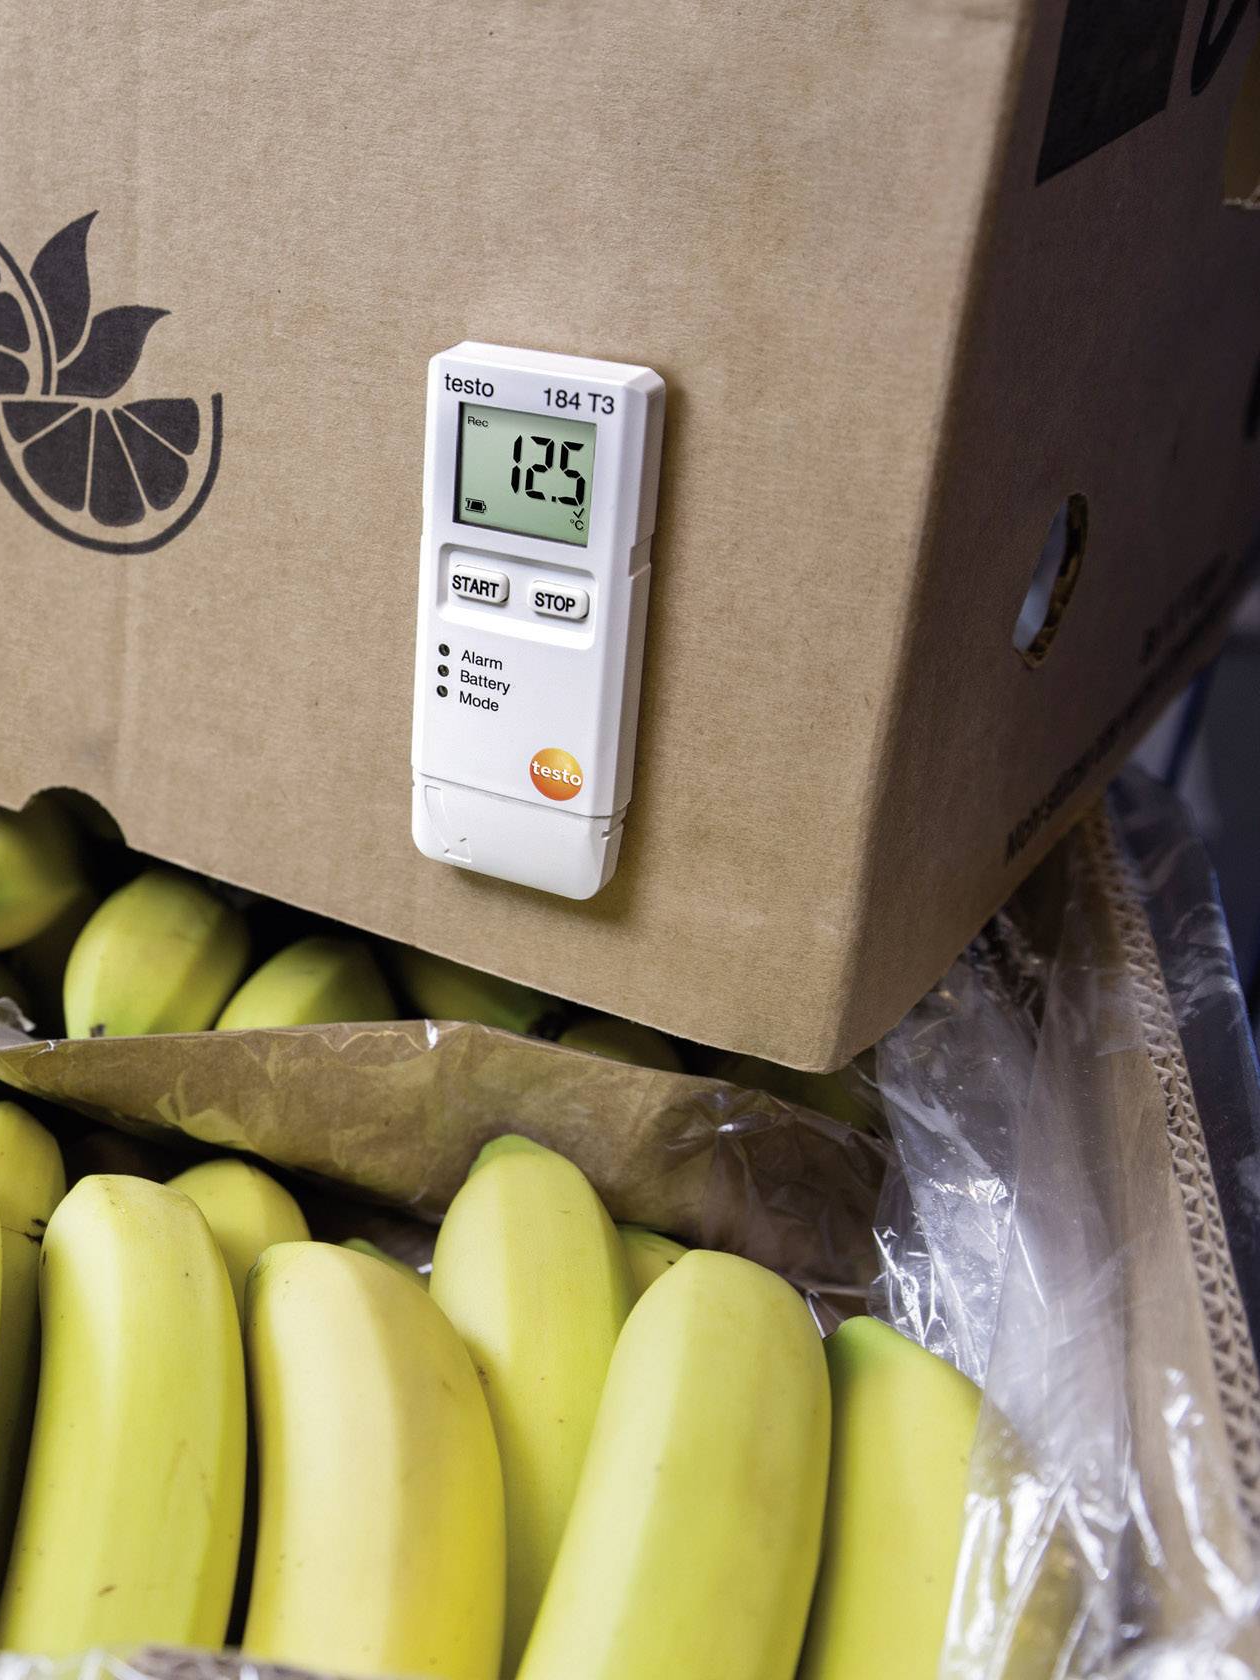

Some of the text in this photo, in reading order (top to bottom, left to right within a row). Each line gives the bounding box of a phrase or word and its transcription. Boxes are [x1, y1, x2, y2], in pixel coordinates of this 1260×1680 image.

[444, 373, 615, 415] testo 184 T3
[467, 416, 489, 428] Rec
[511, 434, 586, 506] 12.5
[452, 574, 499, 598] START
[534, 592, 576, 613] STOP
[461, 649, 503, 671] Alarm
[460, 670, 510, 695] Battery
[459, 691, 499, 712] Mode
[531, 759, 582, 788] testo
